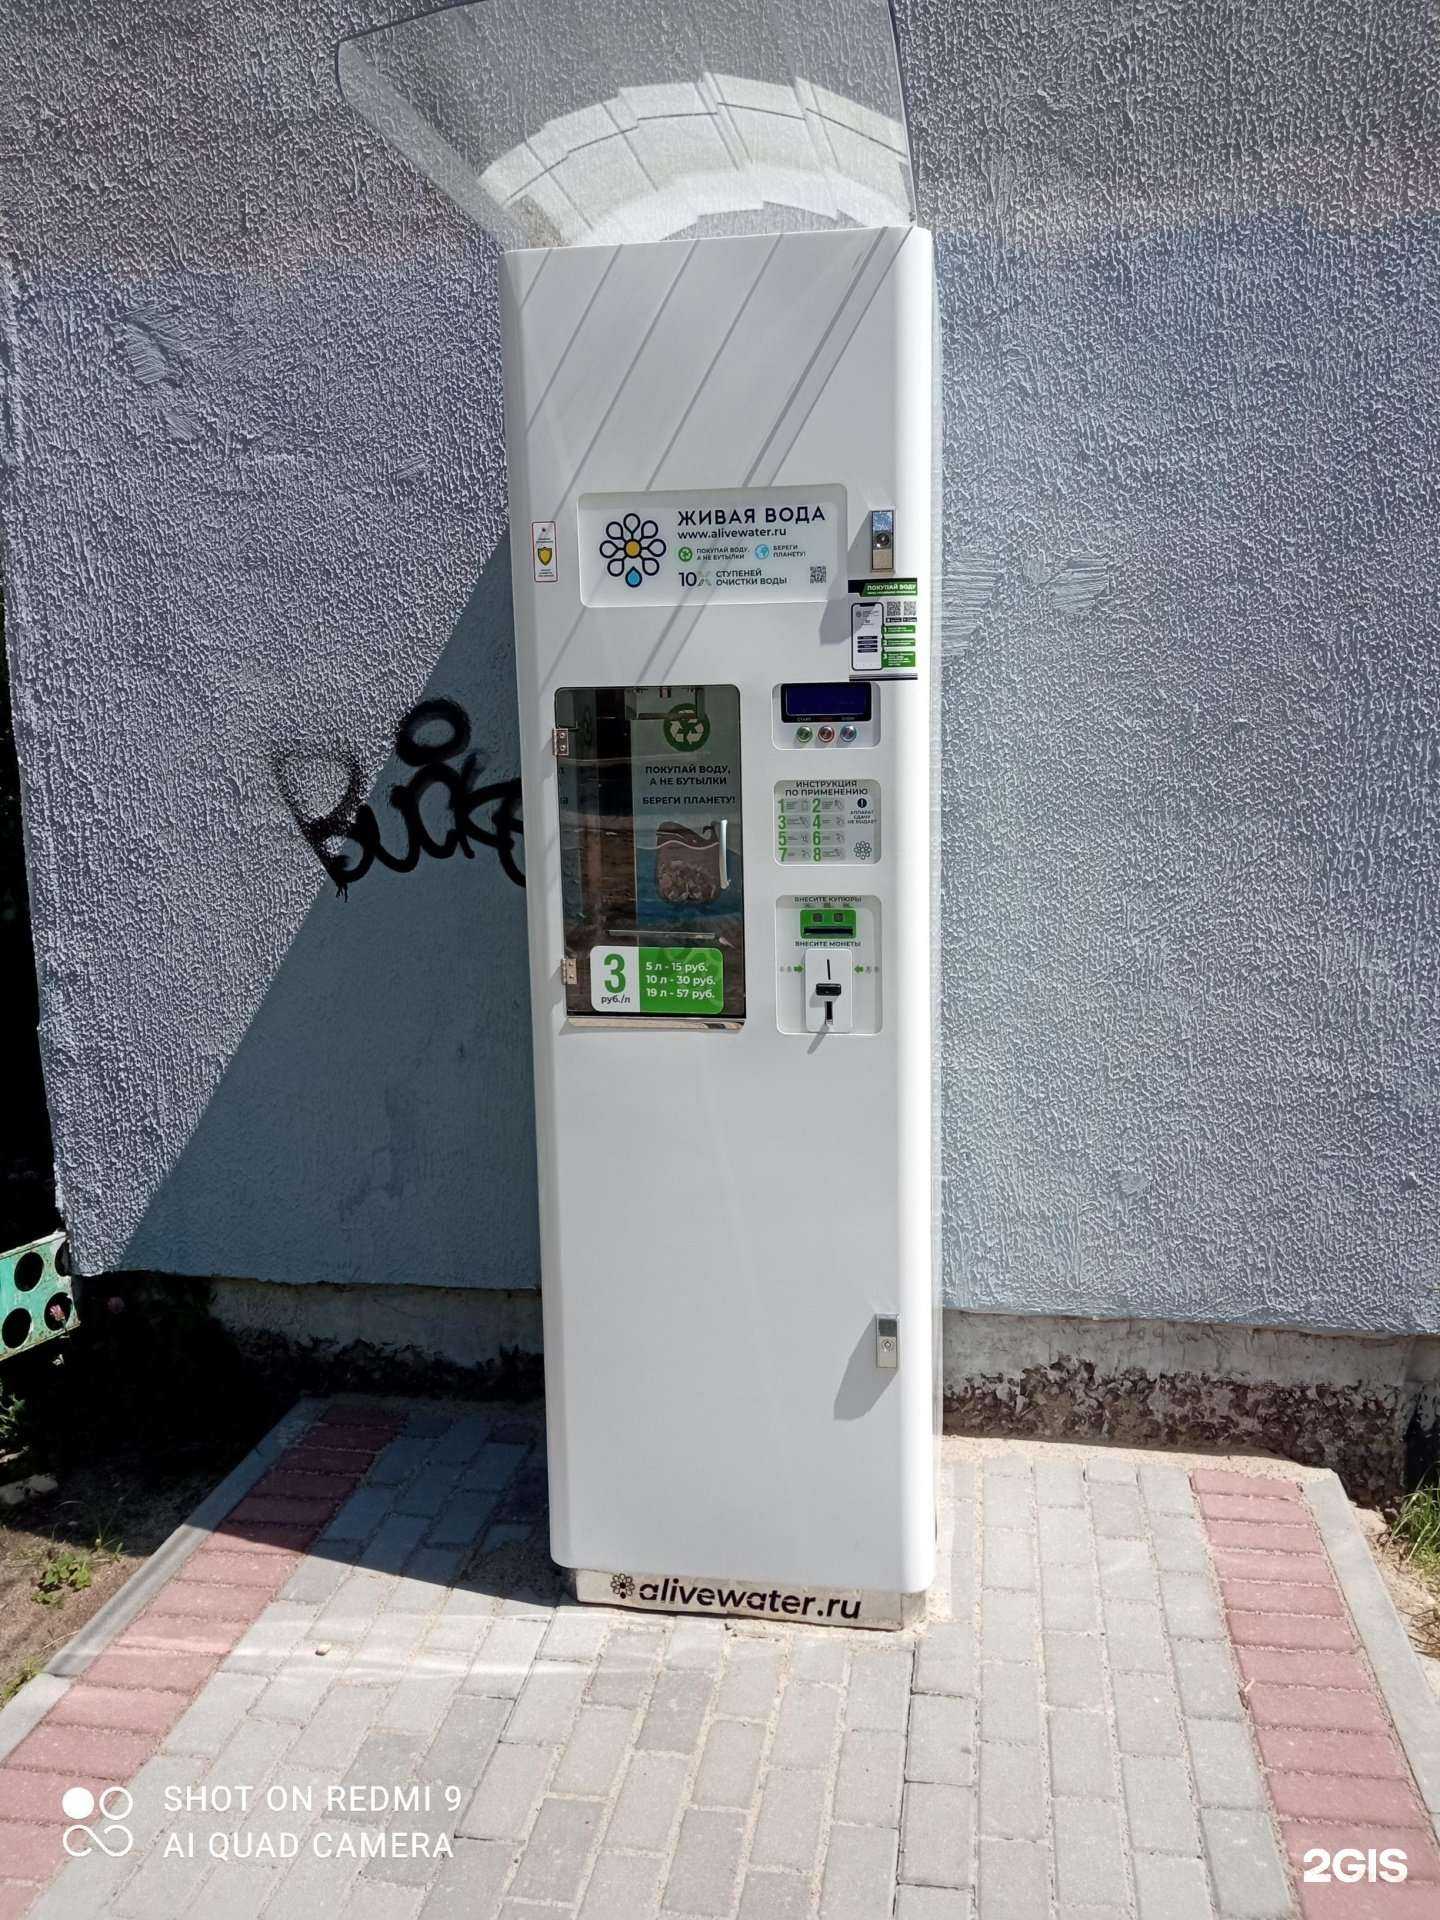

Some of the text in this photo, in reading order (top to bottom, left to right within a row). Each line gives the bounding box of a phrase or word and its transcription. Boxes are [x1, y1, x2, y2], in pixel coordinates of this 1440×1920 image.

[678, 506, 825, 526] ЖИВАЯ ВОДА
[677, 528, 787, 539] www.alivewater.ru
[716, 568, 762, 578] СТУПЕНЕЙ
[716, 578, 788, 586] ОЧИСТКИ ВОДЫ
[645, 764, 731, 774] ПОКУПАЙ ВОДУ,
[676, 777, 727, 785] БУТЫЛКИ
[796, 780, 857, 788] ИНСТРУКЦИЯ
[801, 788, 868, 796] ПРИМЕНЕНИЮ
[642, 796, 736, 805] БЕРЕГИ ПЛАНЕТУ!
[778, 799, 785, 813] 1
[812, 799, 821, 813] 2
[778, 815, 786, 829] 3
[813, 815, 821, 829] 4
[778, 832, 786, 846] 5
[813, 831, 821, 846] 6
[778, 848, 788, 862] 7
[813, 847, 821, 862] 8
[604, 953, 626, 993] 3
[646, 962, 653, 970] 5
[672, 963, 682, 971] 15
[685, 963, 708, 973] руб.
[646, 975, 657, 984] 10
[676, 976, 690, 984] 30
[693, 976, 716, 986] руб.
[646, 988, 657, 997] 19
[676, 989, 689, 997] 57
[692, 989, 715, 999] руб.
[601, 995, 631, 1004] руб./л
[639, 1578, 862, 1619] alivewater.ru
